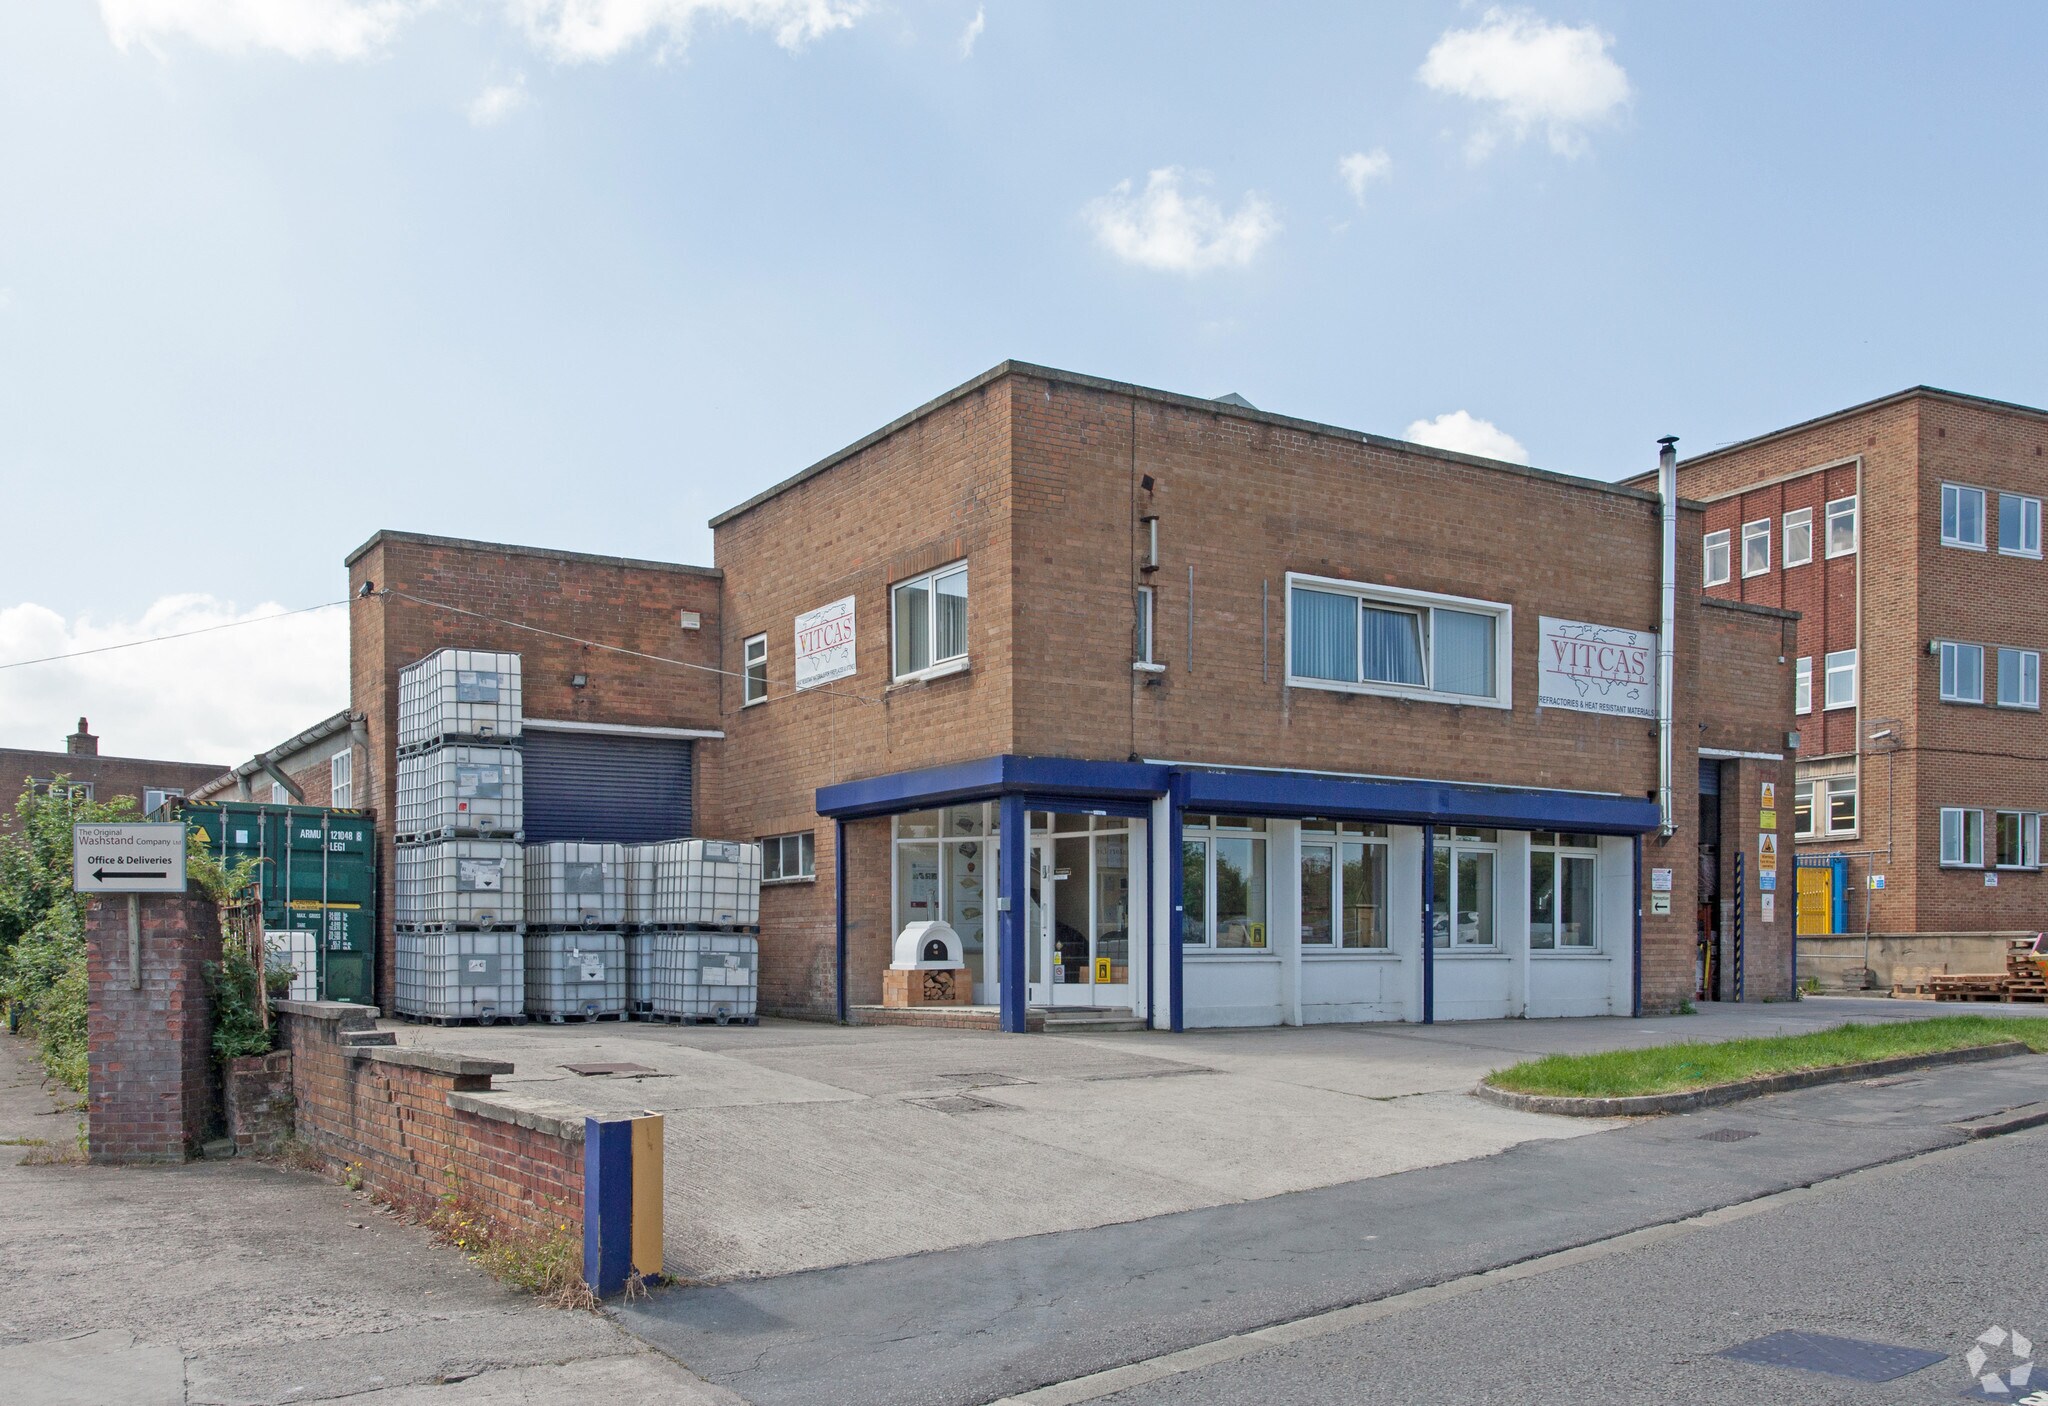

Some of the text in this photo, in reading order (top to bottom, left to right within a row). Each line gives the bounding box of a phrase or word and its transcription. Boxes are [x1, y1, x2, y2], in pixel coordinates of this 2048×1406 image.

[1557, 664, 1645, 683] LIMITED
[1539, 696, 1579, 708] REFRACTORIES
[1585, 702, 1598, 710] HEAT
[1599, 703, 1627, 713] RESISTANT
[1627, 707, 1655, 717] MATERIALS
[93, 829, 122, 837] Original
[300, 829, 322, 839] ARMU
[330, 831, 353, 840] 121048
[79, 836, 134, 846] Washstand
[136, 838, 171, 847] Company
[329, 842, 346, 851] LEG1
[87, 856, 172, 864] Office & Deliveries
